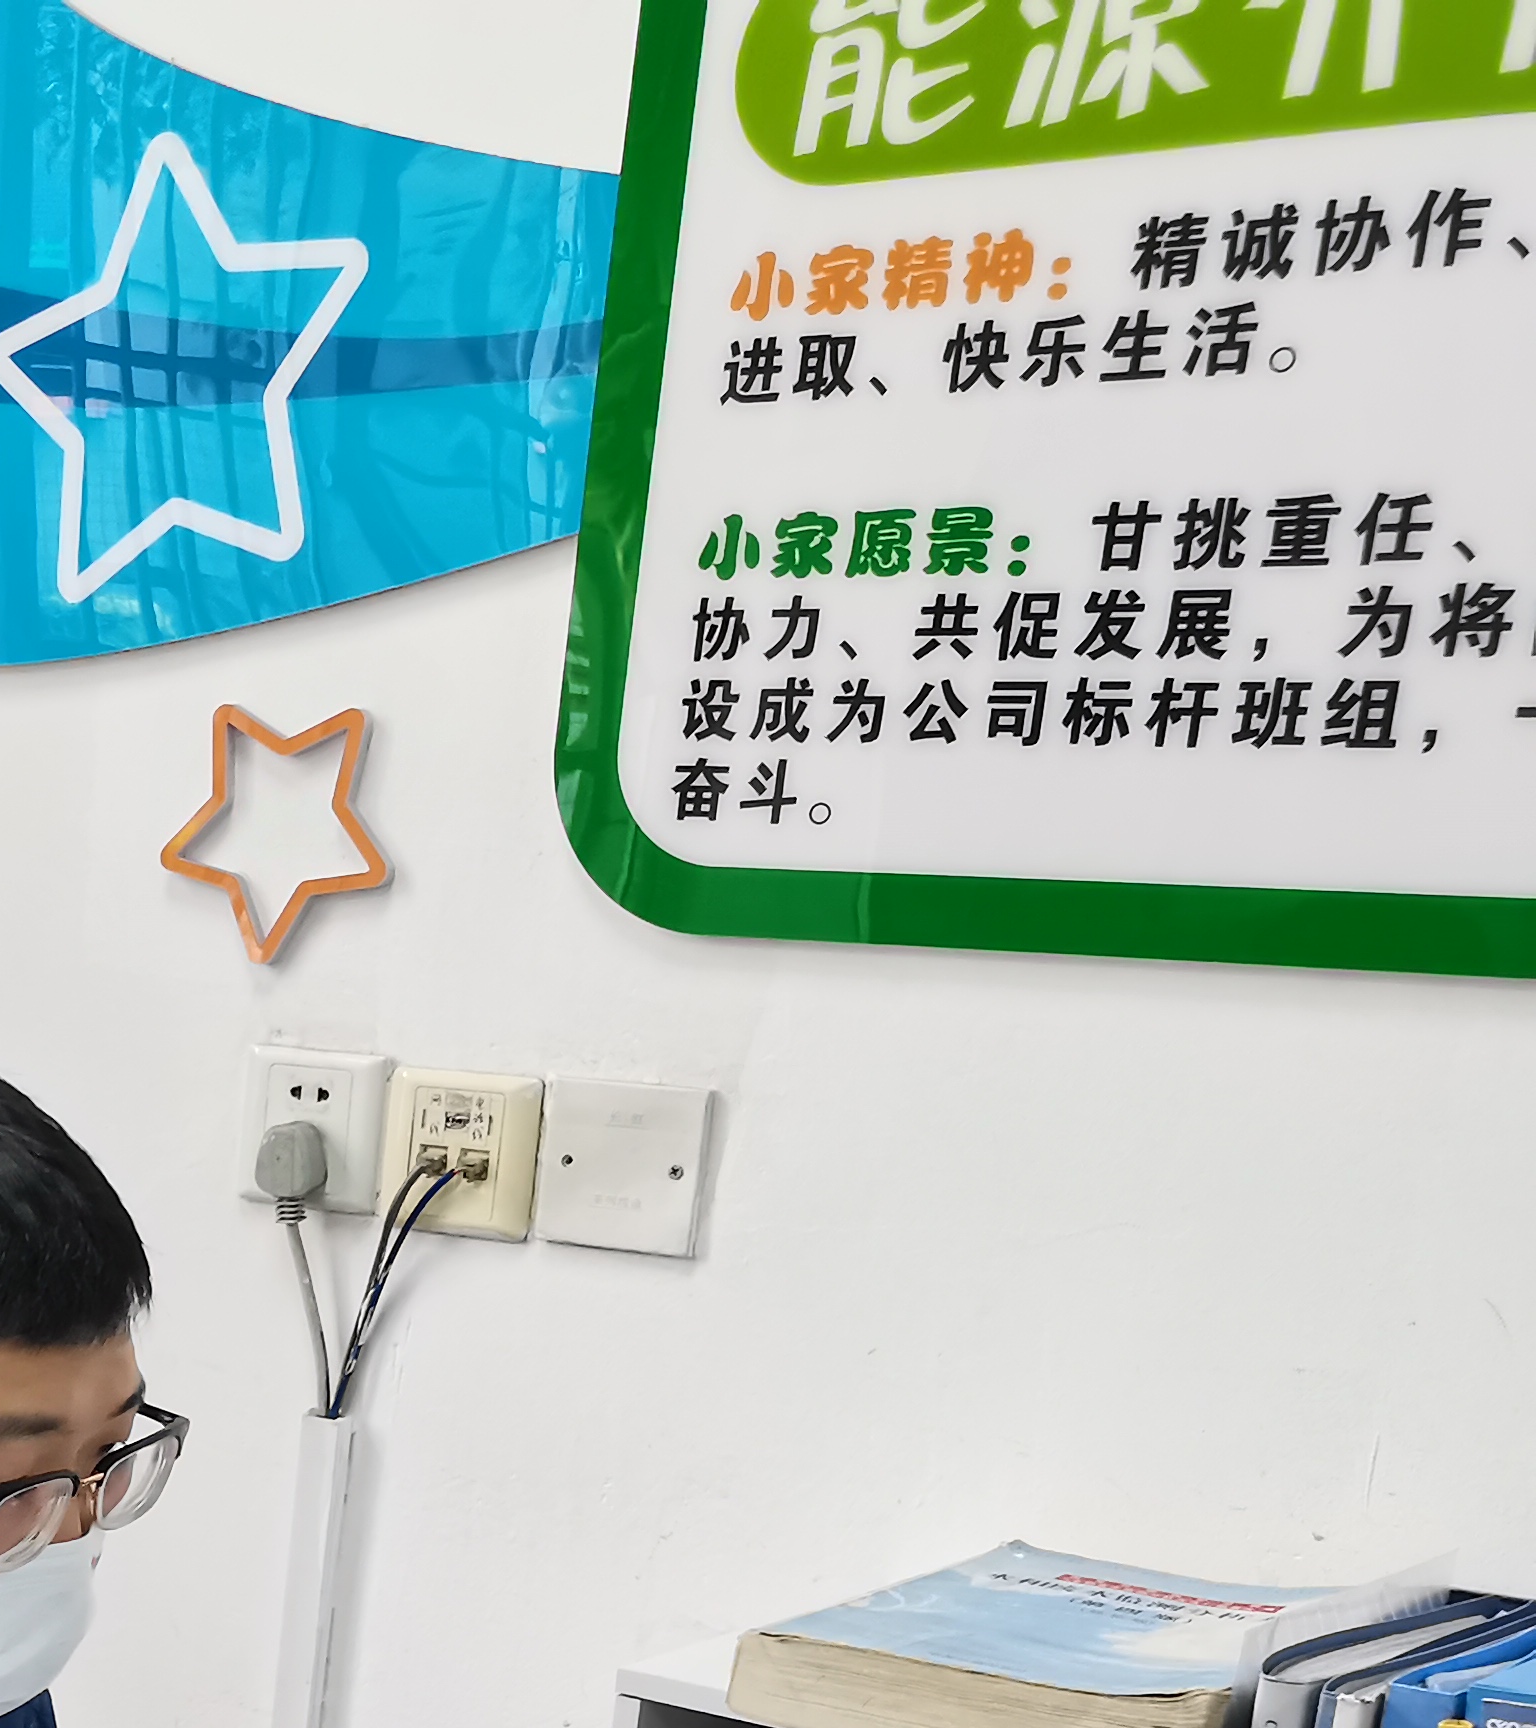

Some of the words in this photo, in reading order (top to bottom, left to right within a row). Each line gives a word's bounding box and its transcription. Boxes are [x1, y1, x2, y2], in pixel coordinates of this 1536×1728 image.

[792, 0, 1536, 156] 能源
[728, 227, 1074, 320] 小家精神：
[1130, 187, 1536, 290] 精诚协作、
[719, 300, 1297, 406] 进取、快乐生活。
[697, 505, 1034, 579] 小家愿景：
[1090, 491, 1484, 573] 甘挑重任、
[691, 580, 1536, 662] 协力、共促发展，为将
[671, 757, 832, 825] 奋斗。
